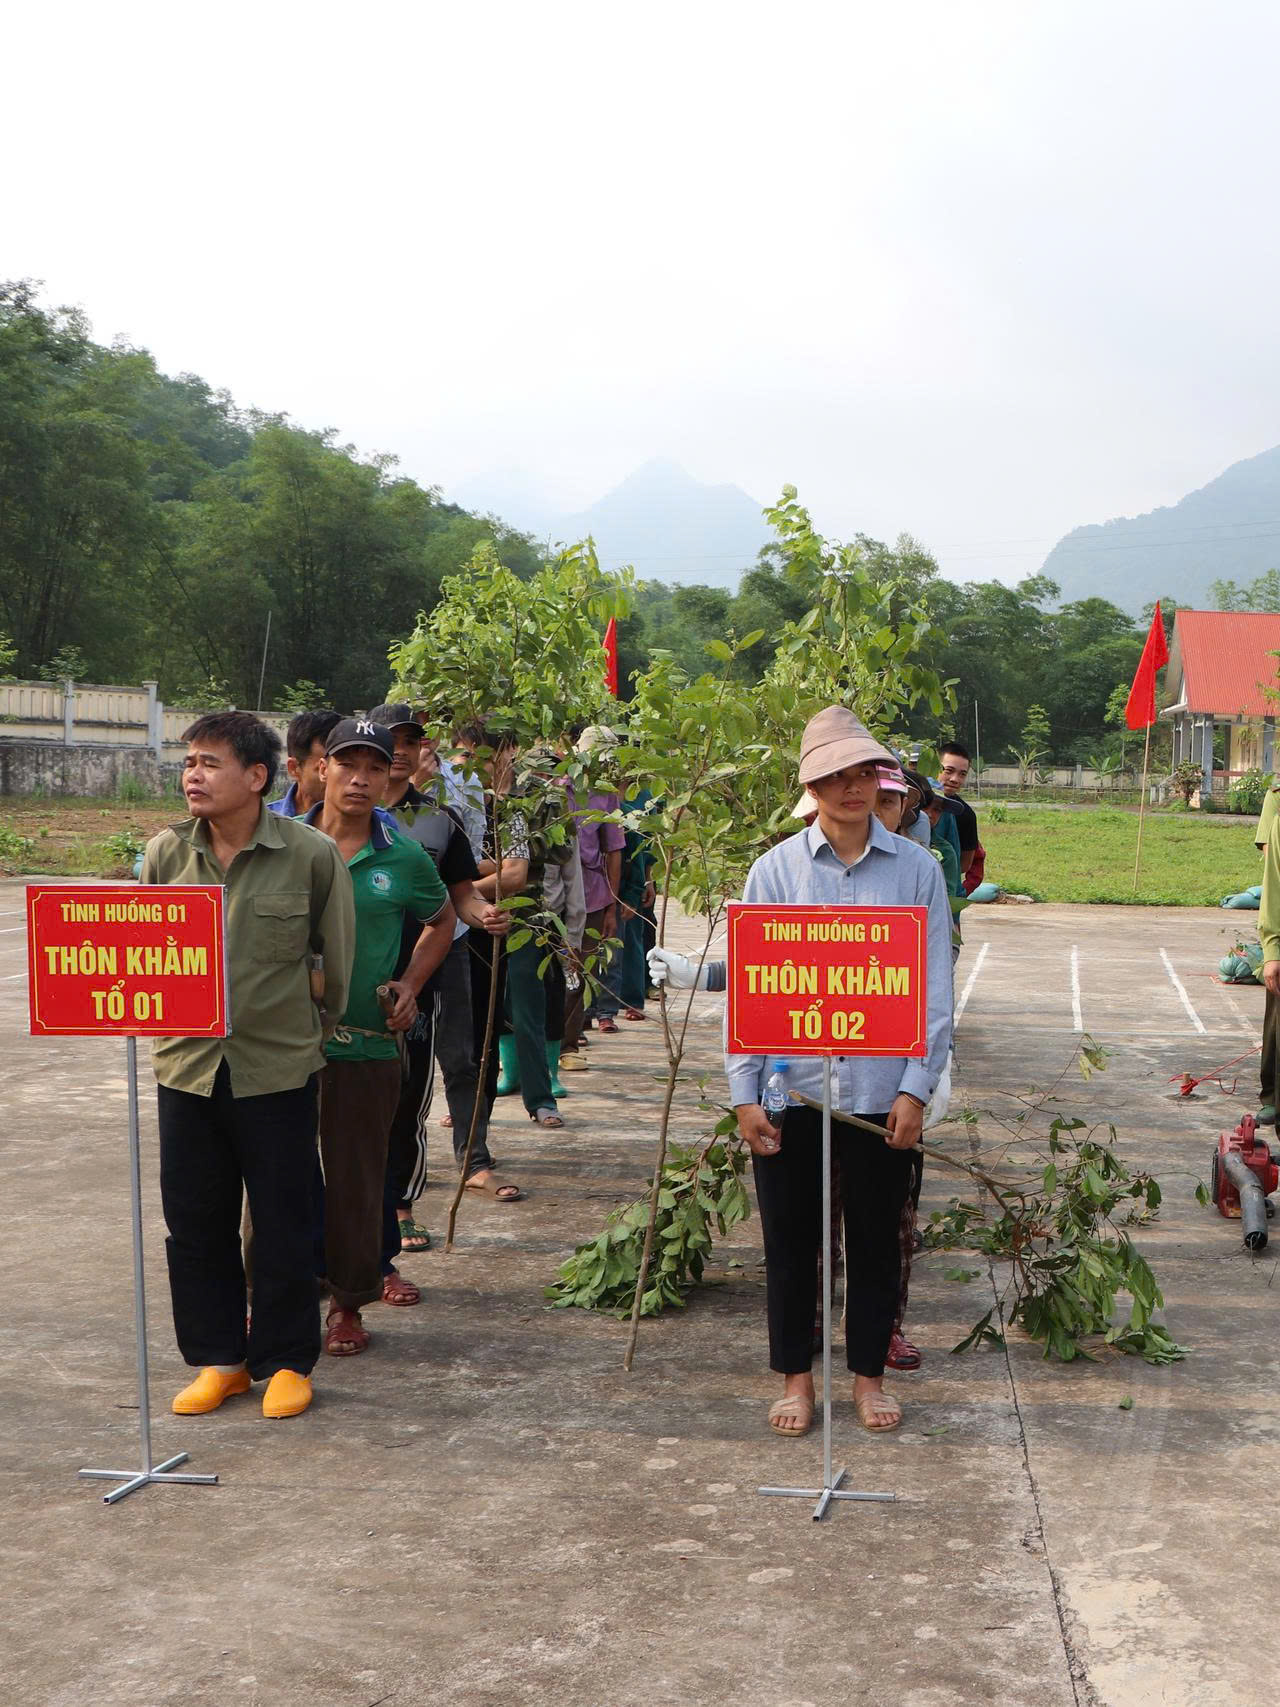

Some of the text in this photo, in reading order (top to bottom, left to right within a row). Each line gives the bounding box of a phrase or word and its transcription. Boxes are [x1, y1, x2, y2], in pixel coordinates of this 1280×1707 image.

[60, 897, 186, 923] TÌNH HUỐNG 01
[762, 916, 890, 943] TÌNH HUỐNG 01
[44, 935, 207, 976] THÔN KHẰM
[744, 955, 910, 996] THÔN KHẰM
[91, 980, 163, 1020] TỔ 01
[788, 999, 865, 1040] TỔ 02
